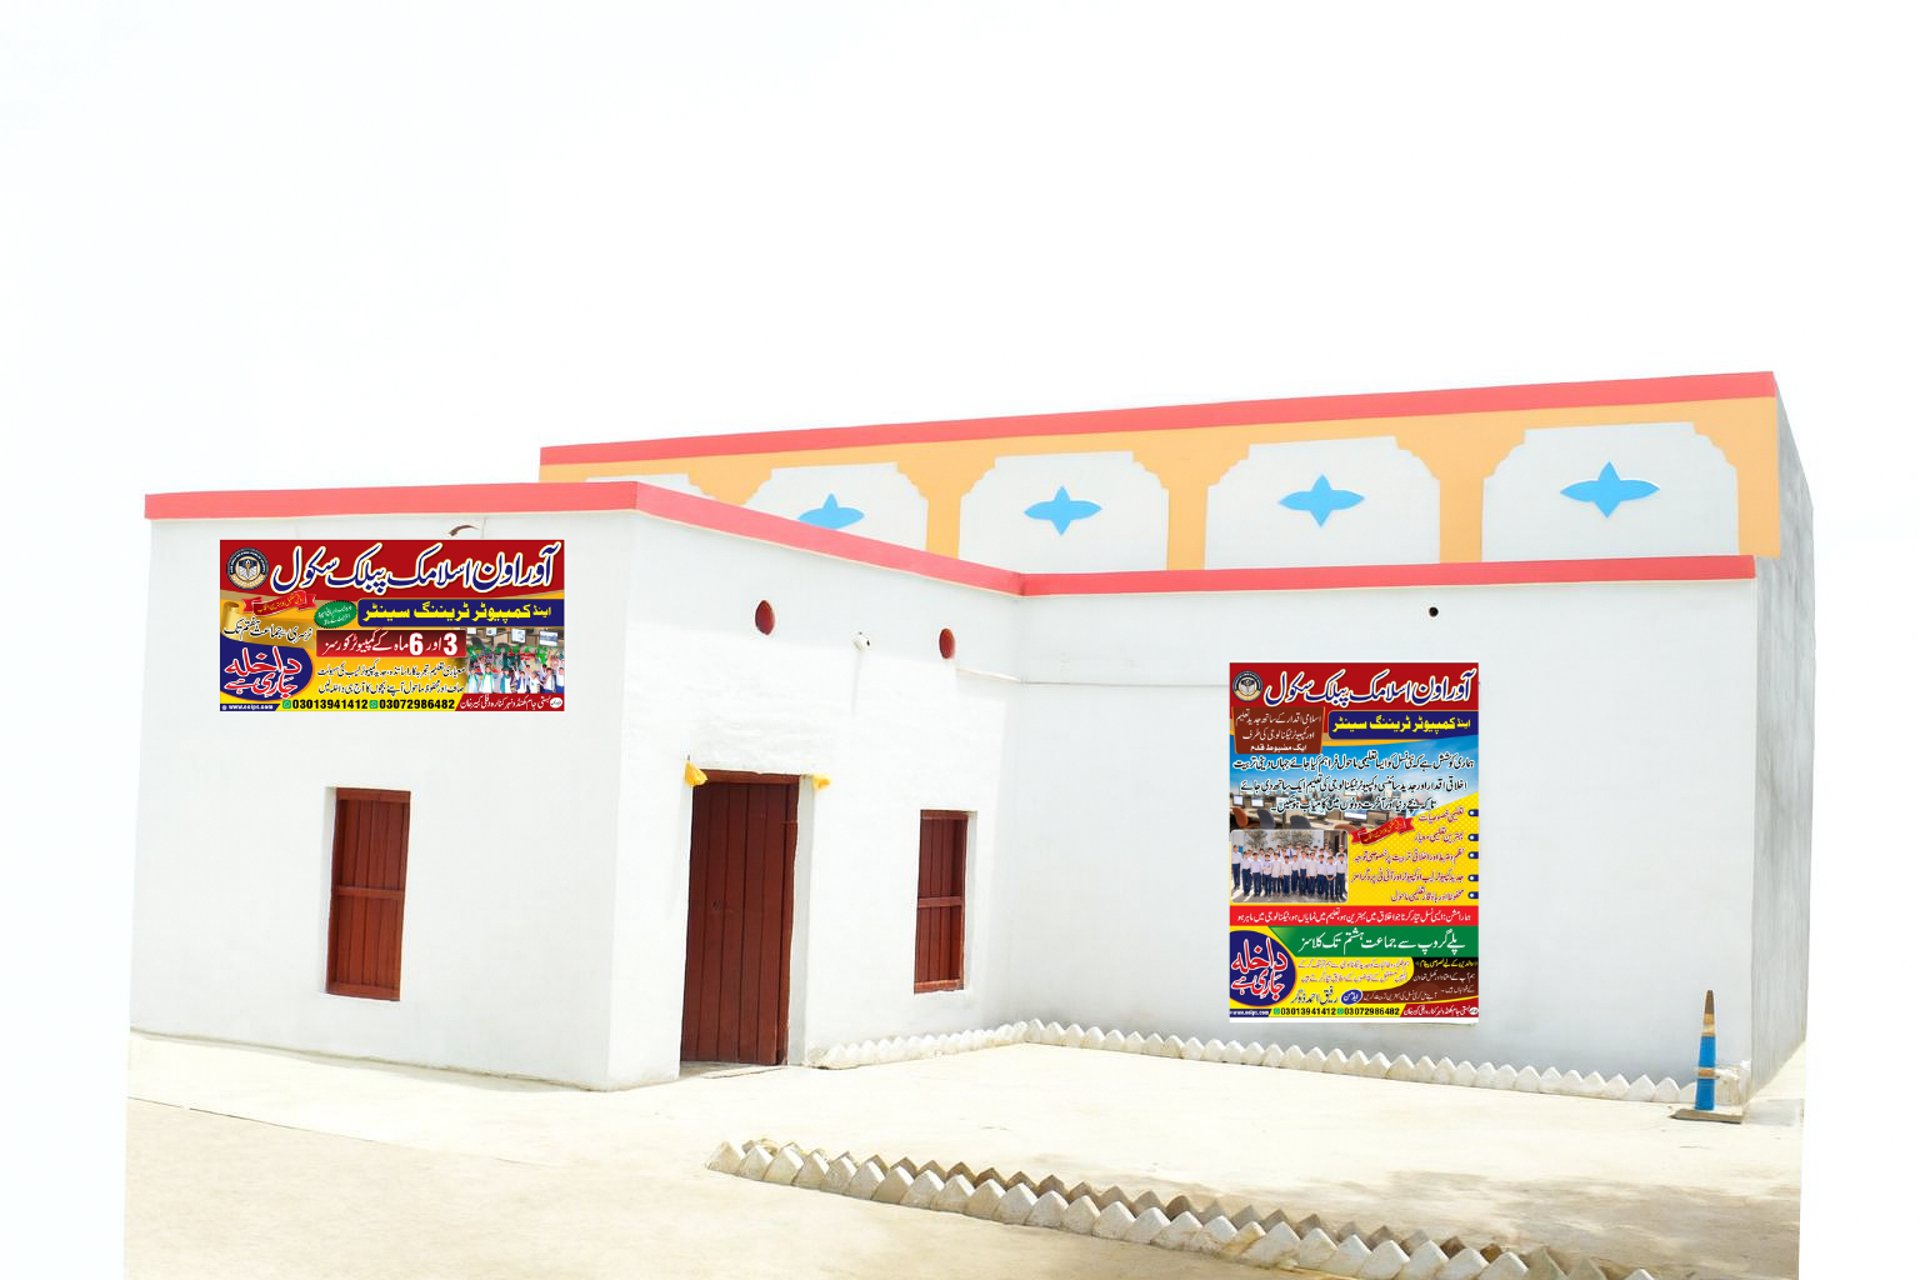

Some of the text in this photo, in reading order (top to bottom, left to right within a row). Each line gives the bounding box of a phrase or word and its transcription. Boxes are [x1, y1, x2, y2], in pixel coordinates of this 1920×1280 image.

[270, 545, 340, 594] سکول
[325, 542, 388, 595] پبلک
[387, 542, 473, 589] اسلامک
[362, 603, 411, 622] سینٹر
[413, 602, 470, 622] ٹریننگ
[472, 602, 531, 624] کمپیوٹر
[350, 627, 384, 653] کمپیوٹر
[371, 631, 393, 651] کے
[394, 634, 409, 651] ماہ
[409, 633, 424, 656] 6
[426, 637, 442, 651] اور
[443, 633, 458, 656] 3
[224, 646, 303, 677] داخلہ
[224, 673, 299, 699] جاری ہے
[1264, 671, 1315, 707] سکول
[1304, 668, 1350, 708] پبلک
[1349, 668, 1412, 703] اسلامک
[292, 699, 368, 710] 03013941412
[379, 699, 455, 710] 03072986482
[1276, 712, 1287, 723] کے
[1287, 712, 1302, 723] اقدار
[1302, 713, 1321, 725] اسلامی
[1332, 716, 1367, 732] سینٹر
[1369, 715, 1411, 733] ٹریننگ
[1412, 715, 1456, 734] کمپیوٹر
[1242, 729, 1260, 740] طرف
[1306, 732, 1315, 740] اور
[1250, 743, 1307, 753] ایک مضبوط قدم
[1232, 755, 1257, 770] تربیت
[1336, 754, 1357, 770] ماحول
[1420, 760, 1433, 772] ہے
[1433, 752, 1457, 770] کوشش
[1454, 756, 1475, 770] ہماری
[1446, 775, 1467, 792] اخلاقی
[1297, 927, 1466, 956] پلے گروپ سے جماعت ہشتم تک کلاسز
[1231, 937, 1288, 974] داخلہ
[1231, 976, 1258, 995] ہے
[1251, 968, 1286, 1001] جاری
[1280, 1008, 1337, 1016] 03013941412
[1344, 1008, 1400, 1016] 03072986482
